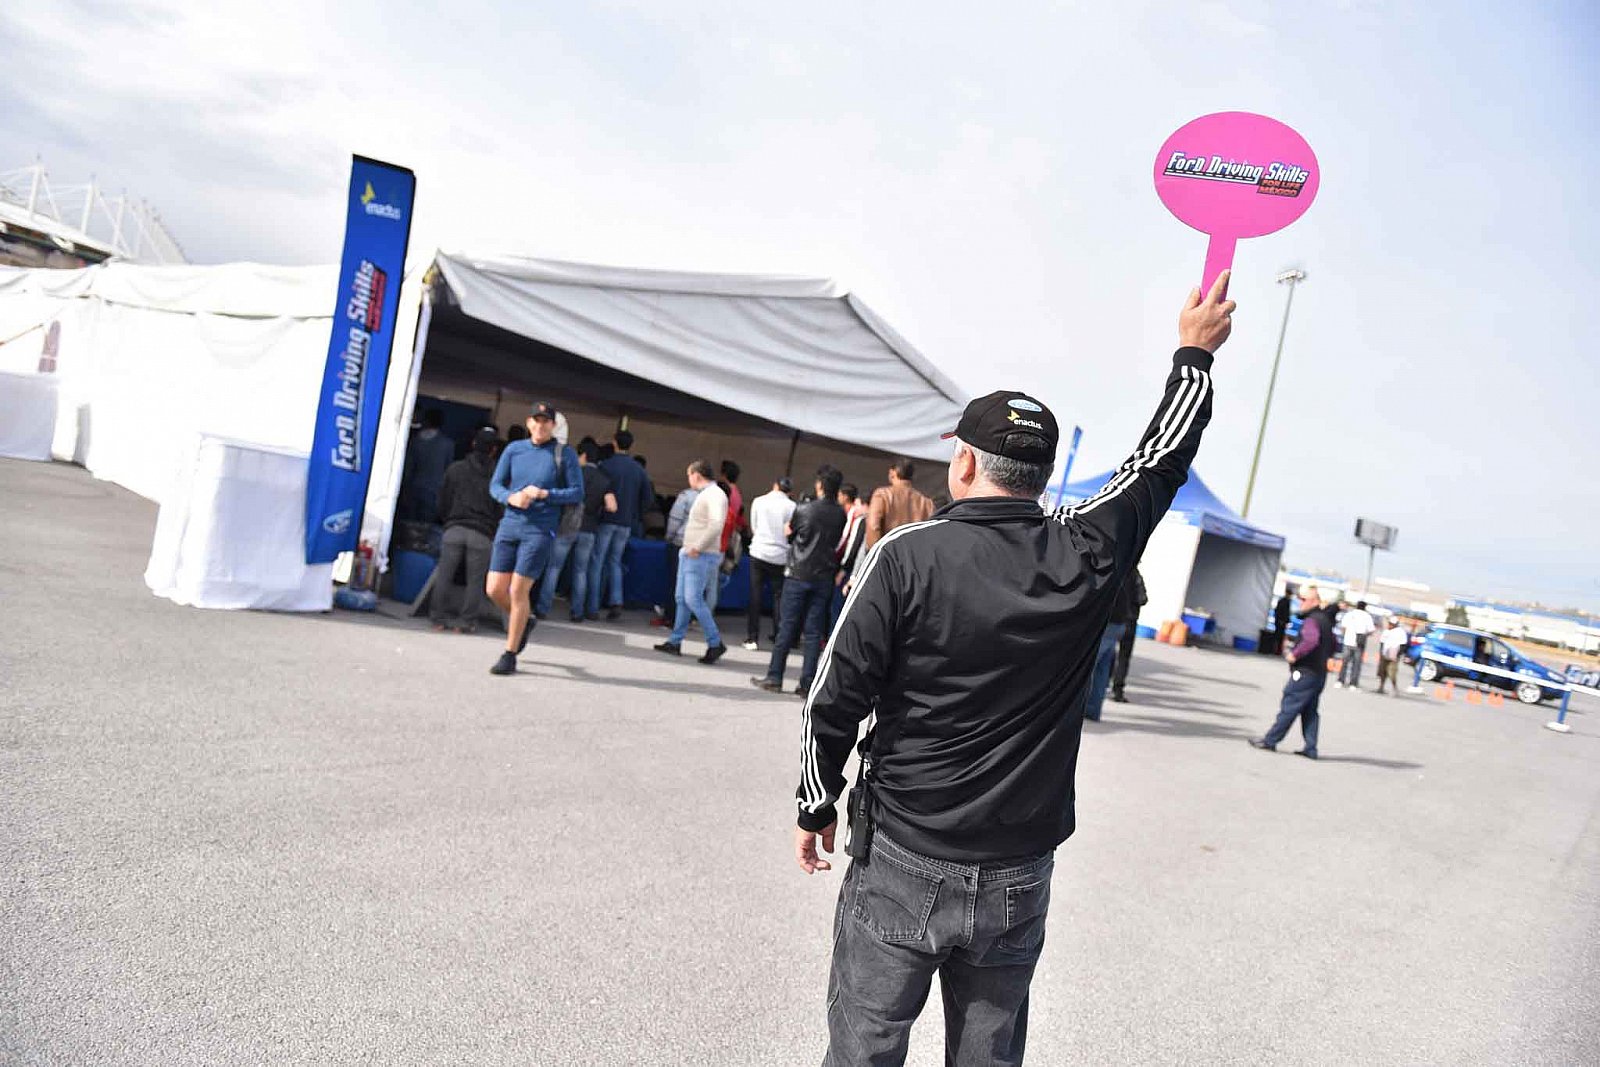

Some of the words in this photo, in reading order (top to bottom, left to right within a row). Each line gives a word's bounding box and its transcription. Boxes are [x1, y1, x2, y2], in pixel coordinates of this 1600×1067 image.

[1208, 155, 1264, 183] Driving
[1265, 162, 1309, 183] Skills
[346, 260, 375, 325] Skills
[333, 327, 371, 411] Driving
